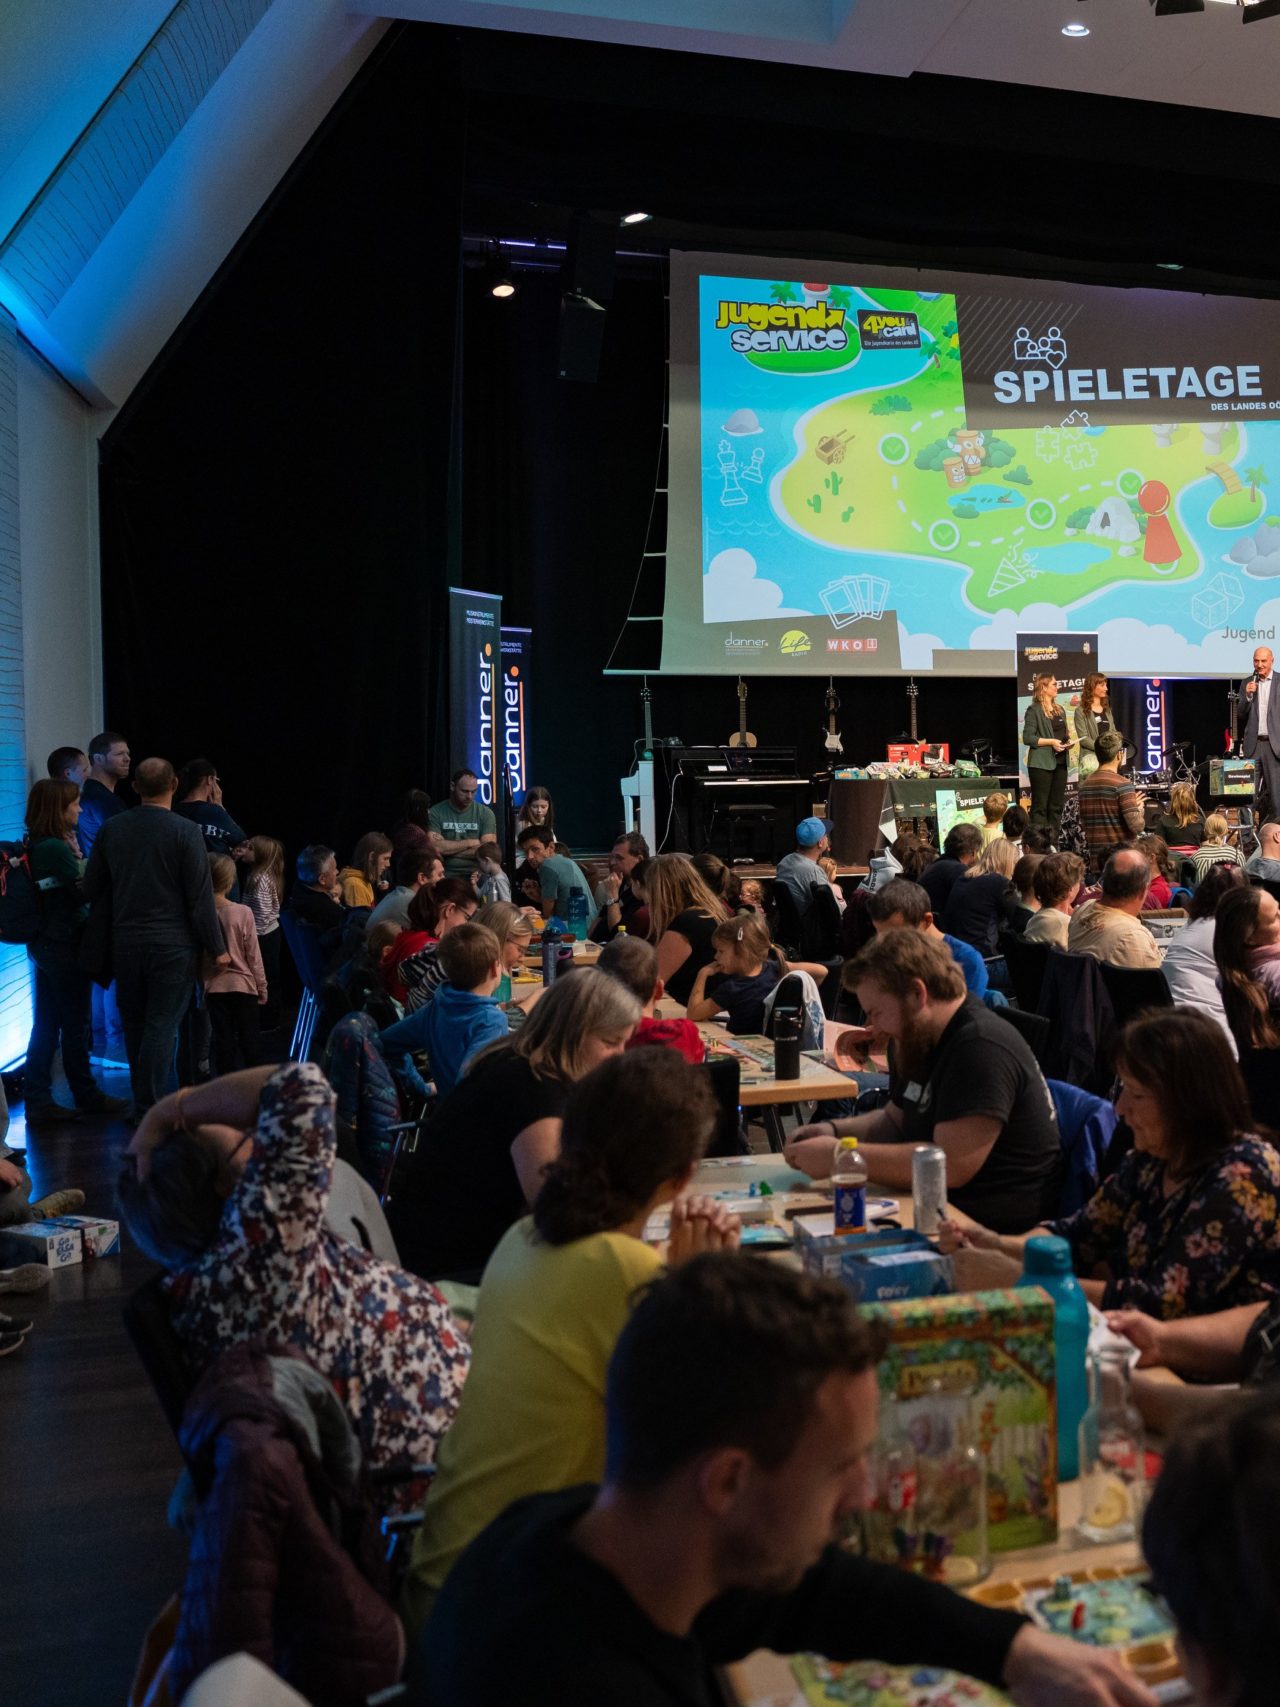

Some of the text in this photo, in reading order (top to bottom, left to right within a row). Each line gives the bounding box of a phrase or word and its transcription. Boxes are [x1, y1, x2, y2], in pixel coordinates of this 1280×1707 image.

[732, 328, 847, 351] service
[993, 365, 1263, 404] SPIELETAGE
[1211, 403, 1229, 411] DES
[1231, 402, 1267, 411] LANDES
[1222, 626, 1275, 643] Jugend
